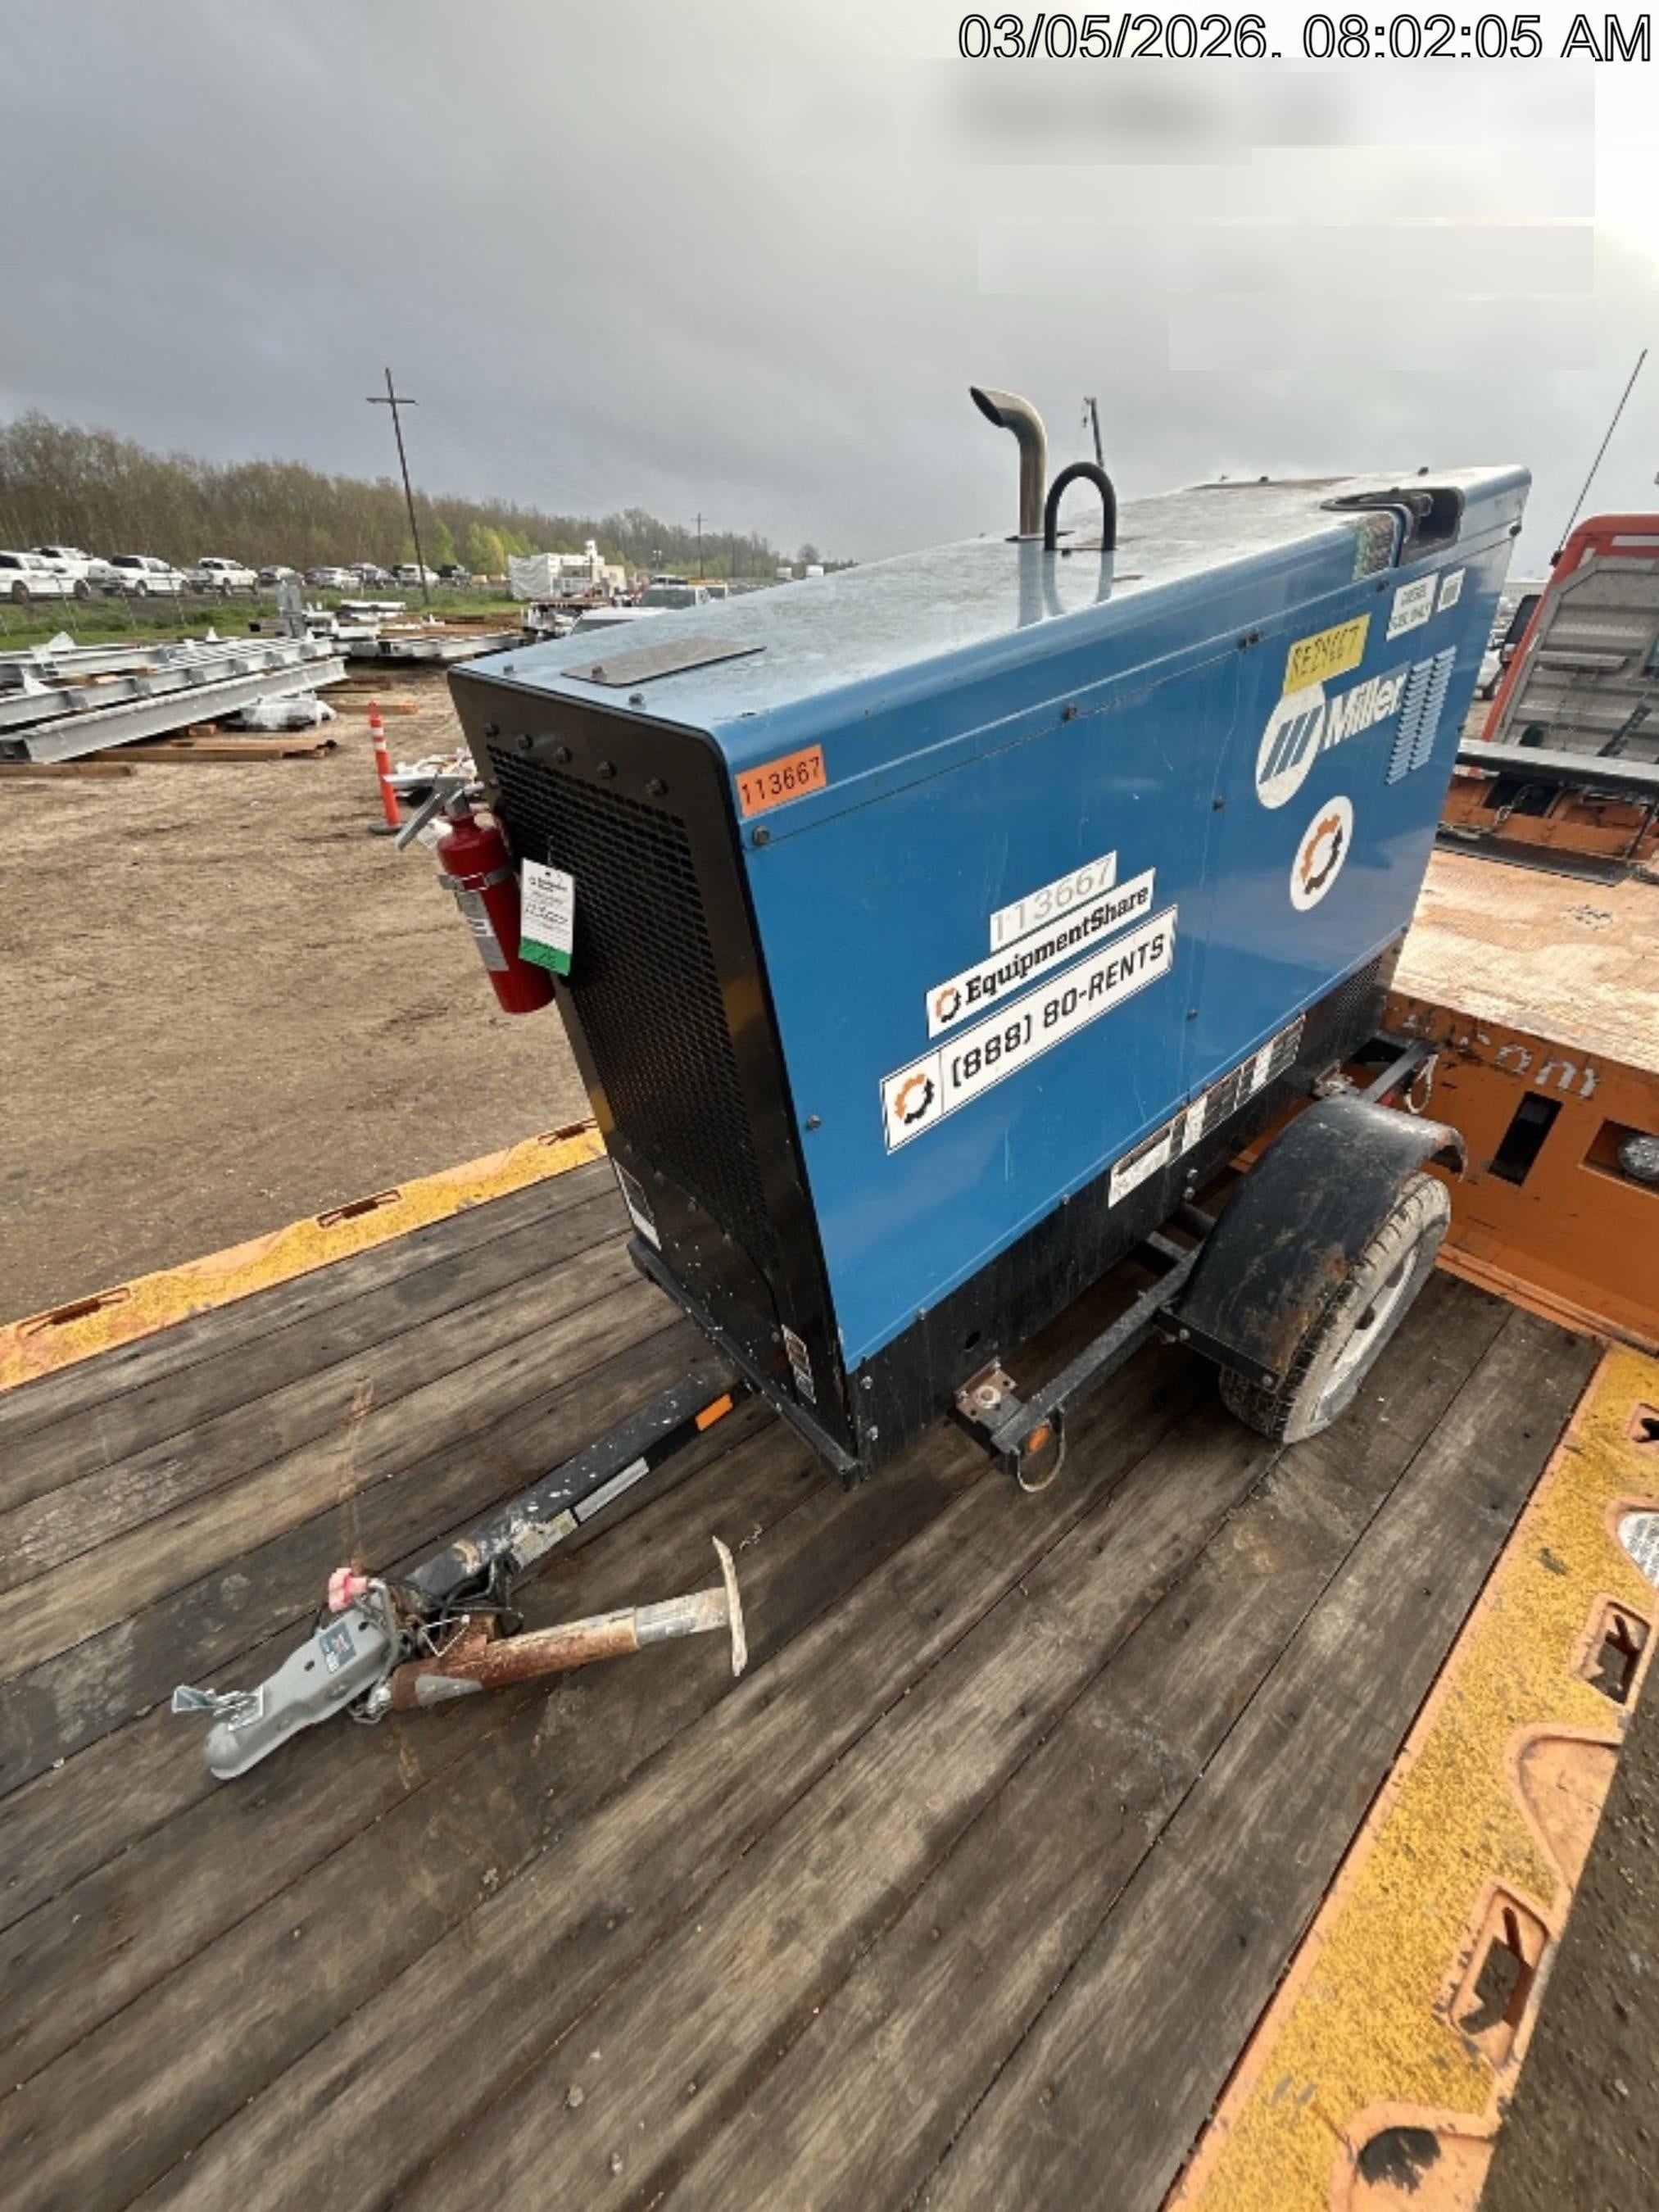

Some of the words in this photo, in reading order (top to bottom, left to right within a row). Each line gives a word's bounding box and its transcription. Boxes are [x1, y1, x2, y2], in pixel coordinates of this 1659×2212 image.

[1324, 673, 1407, 751] Miller
[741, 755, 820, 805] 113667
[990, 857, 1113, 942] 113667
[965, 886, 1149, 1006] EquipmentShare
[951, 1013, 1032, 1088] (888)
[1042, 932, 1165, 1029] 80-RENTS
